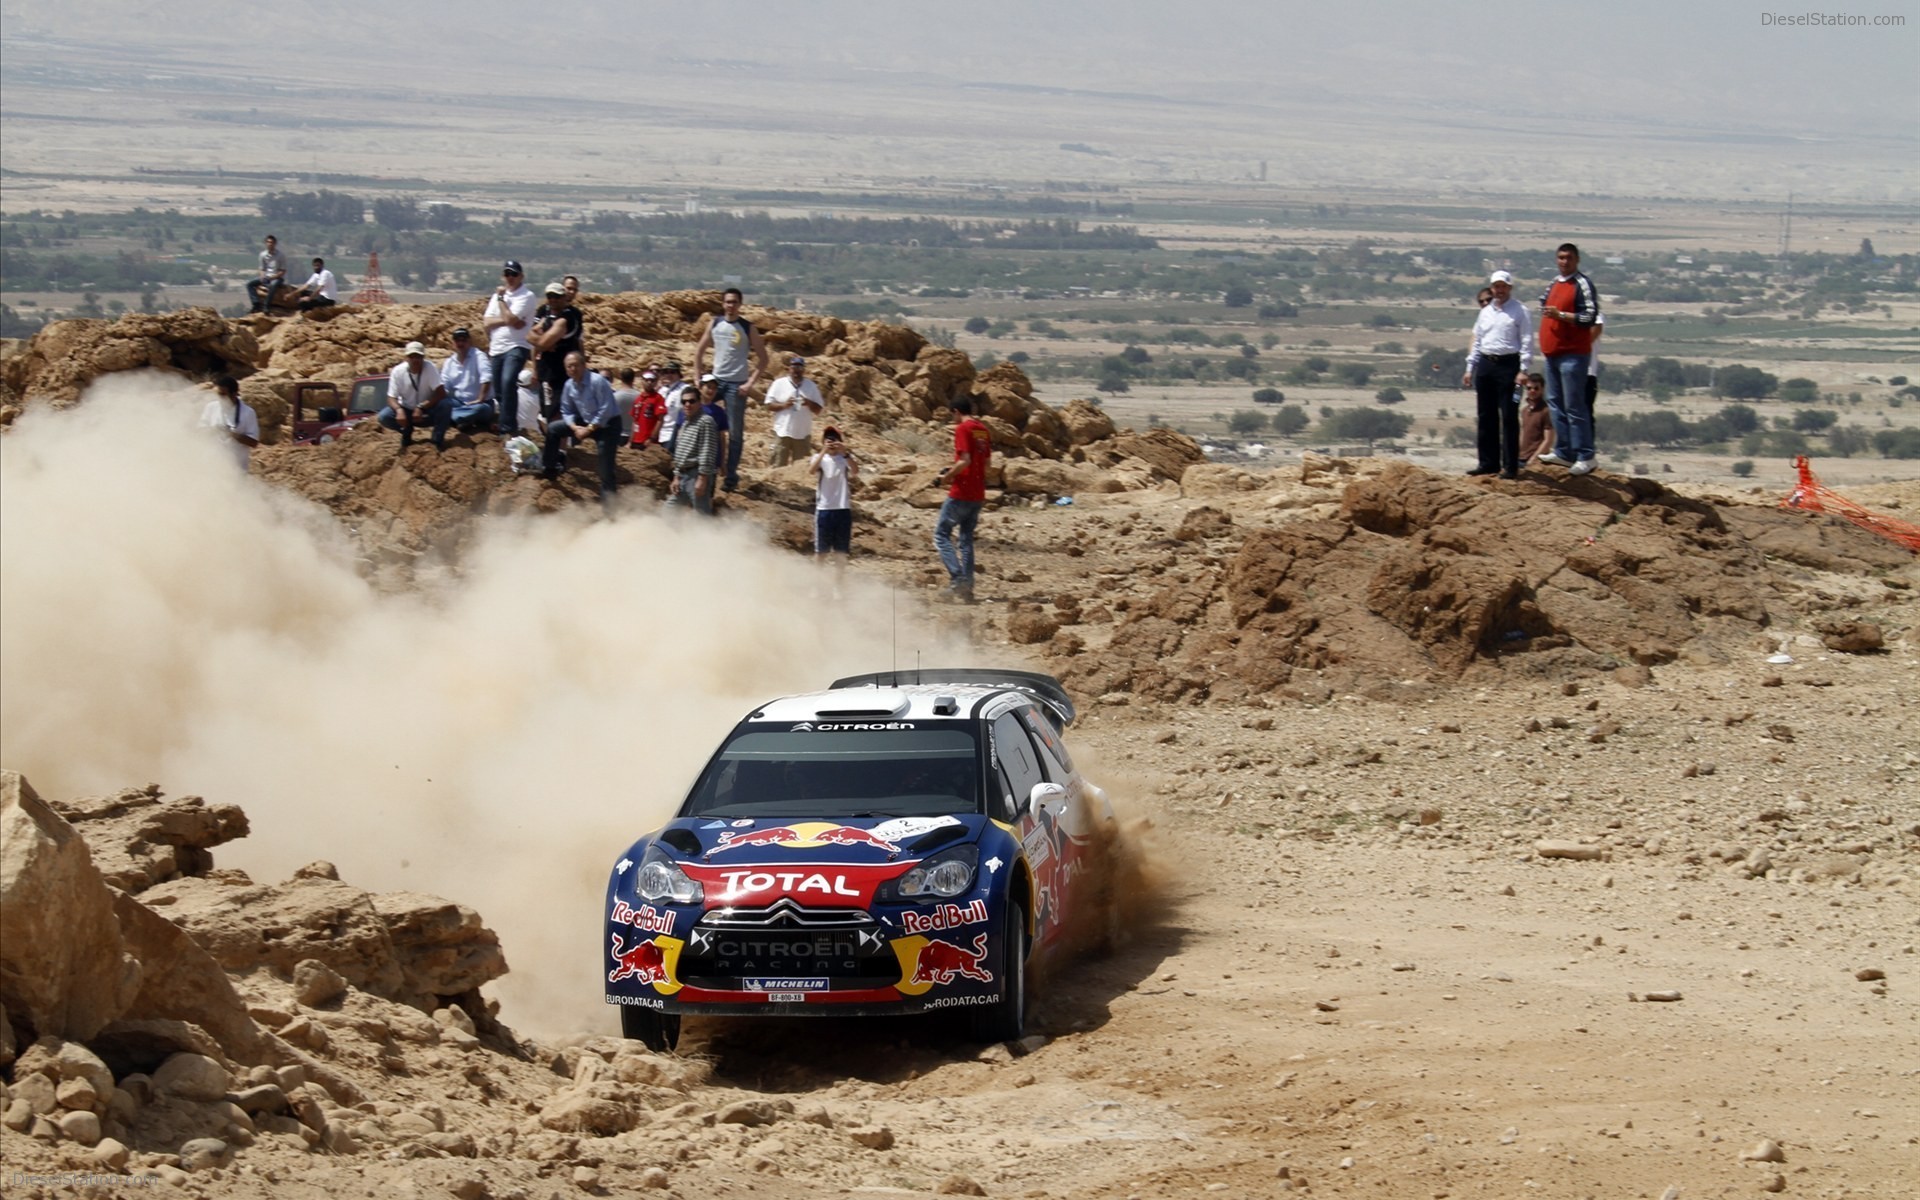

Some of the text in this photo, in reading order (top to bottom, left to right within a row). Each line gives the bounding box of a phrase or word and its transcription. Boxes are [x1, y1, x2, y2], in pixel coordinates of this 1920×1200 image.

[899, 819, 913, 828] 2
[720, 870, 860, 897] TOTAL
[717, 960, 856, 969] RACING
[764, 980, 825, 989] MICHELIN
[606, 994, 664, 1009] EURODATACAR
